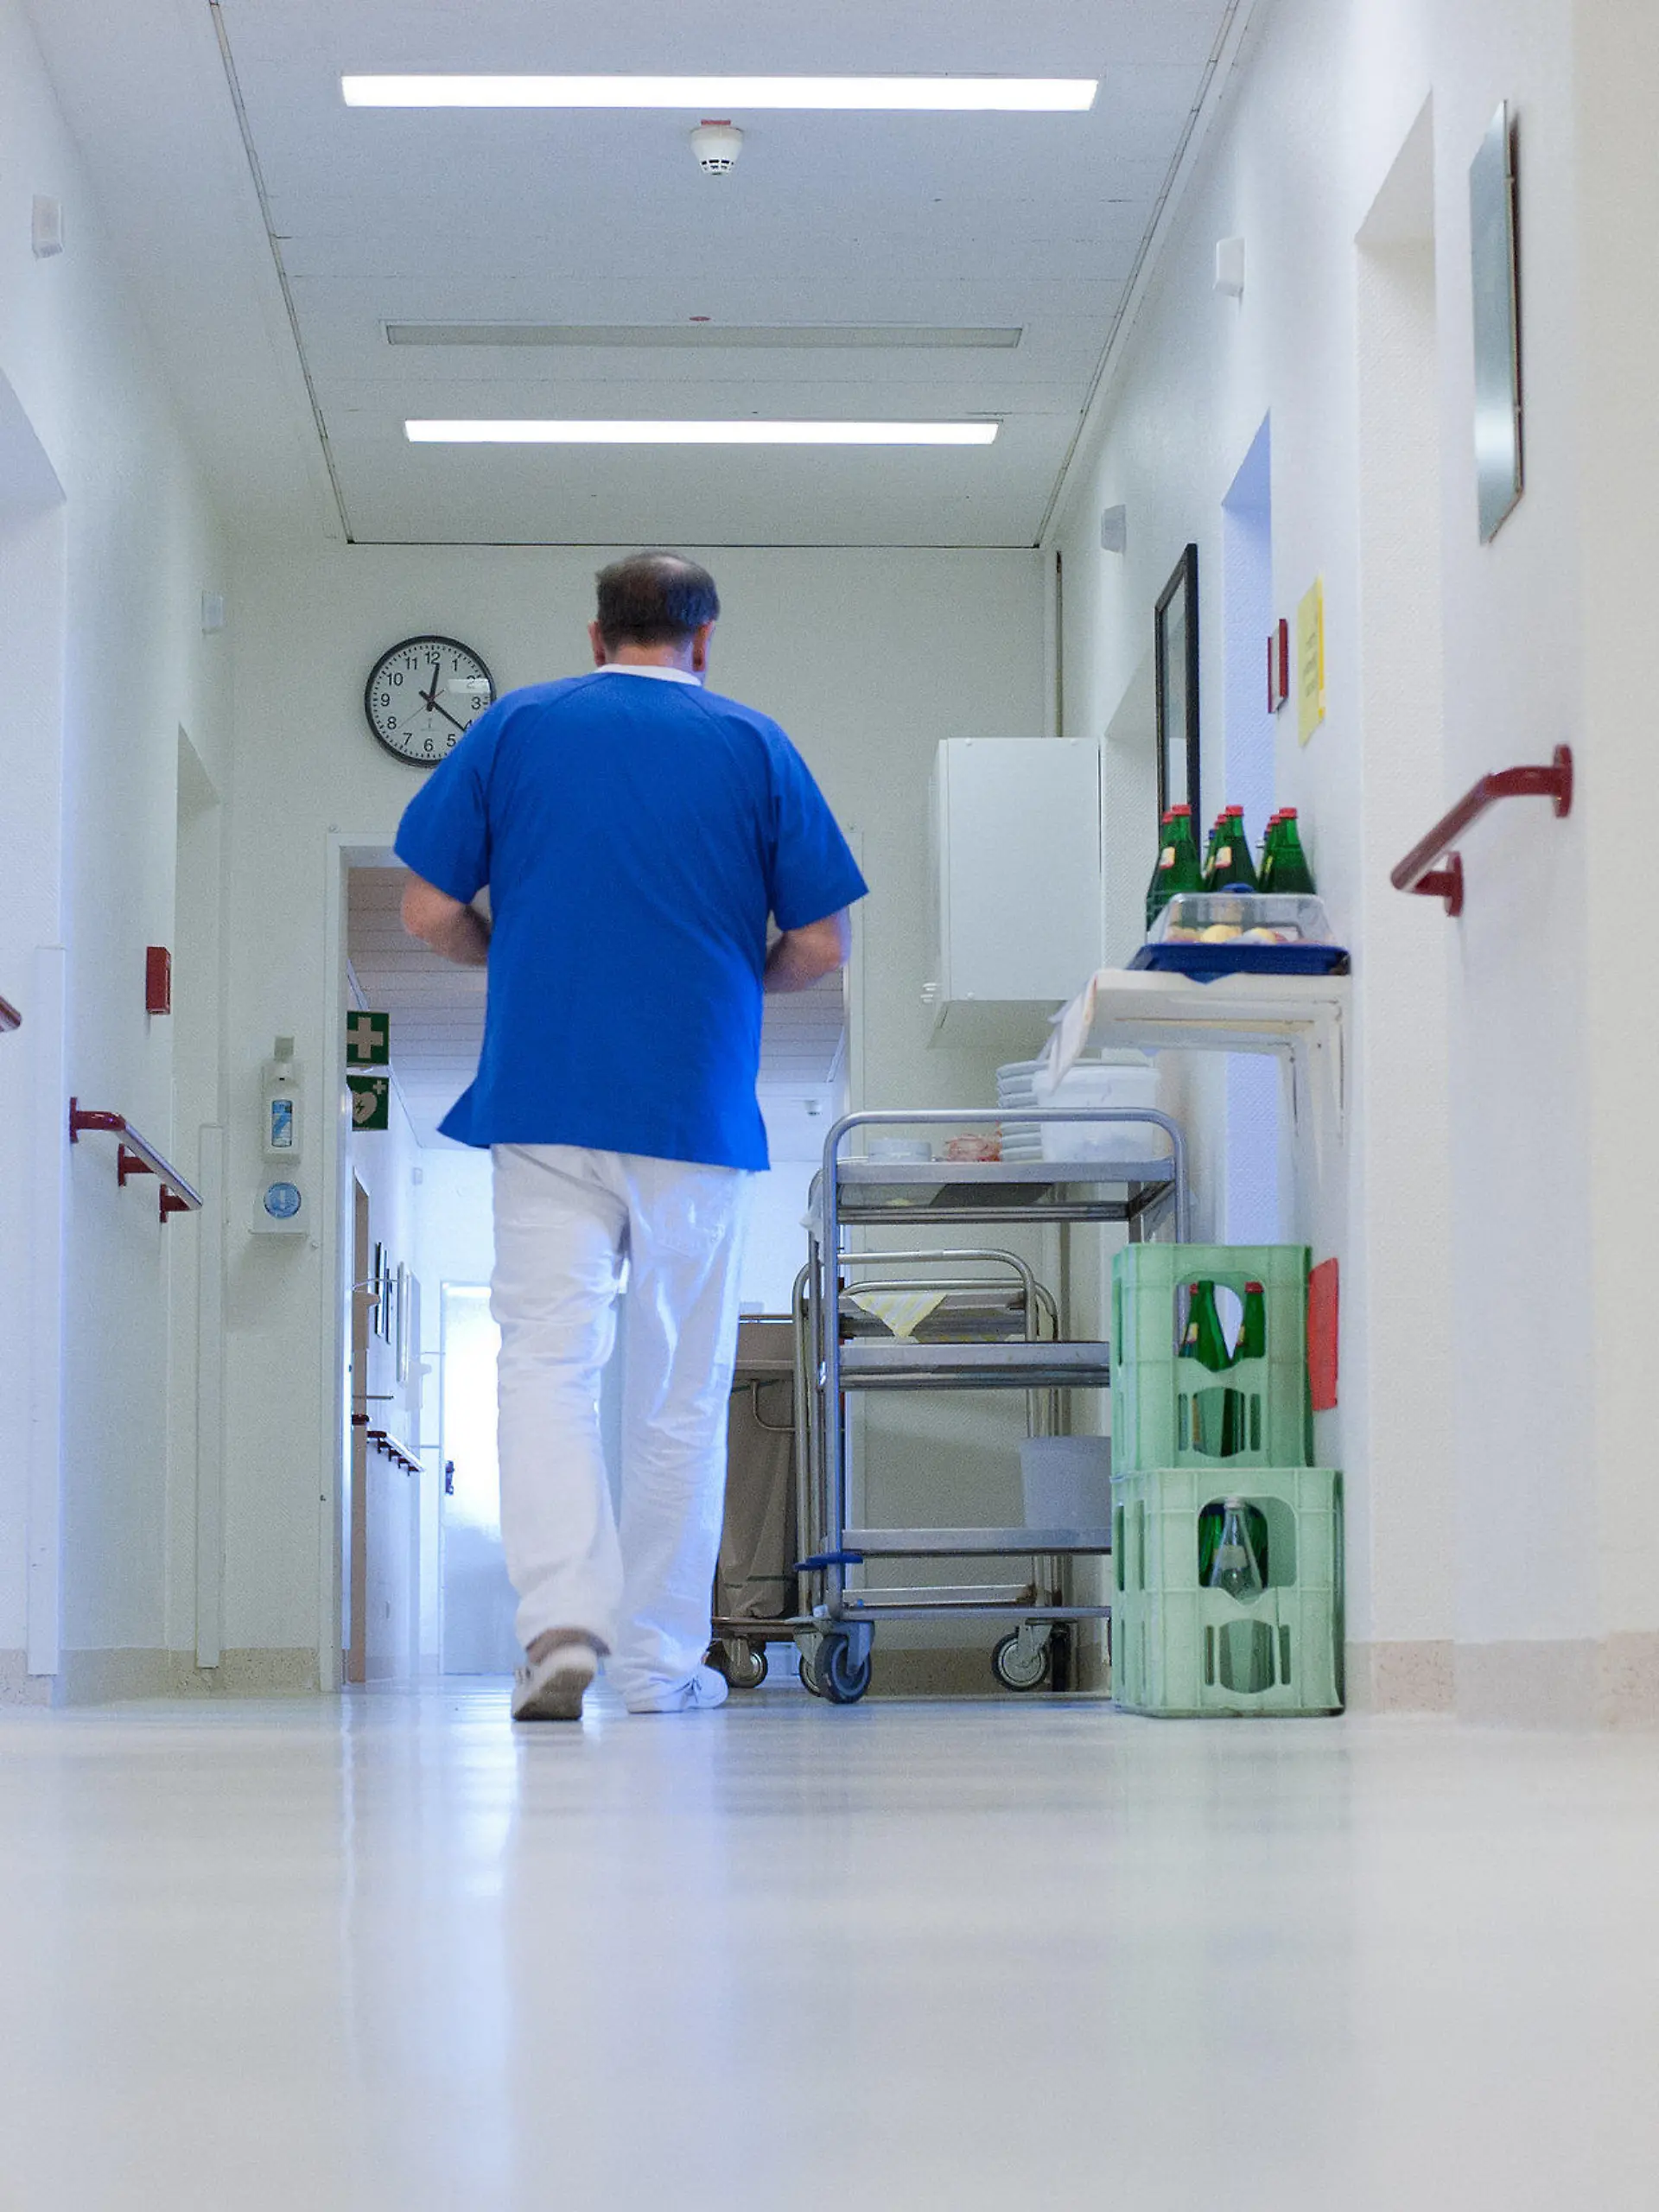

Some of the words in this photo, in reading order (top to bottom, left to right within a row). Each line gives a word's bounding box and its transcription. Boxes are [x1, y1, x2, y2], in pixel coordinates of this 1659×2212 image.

[405, 657, 418, 671] 11
[425, 652, 441, 664] 12
[452, 658, 458, 671] 1
[387, 672, 404, 686] 10
[380, 693, 391, 707] 9
[471, 696, 481, 710] 3
[387, 716, 397, 730] 8
[403, 733, 413, 746] 7
[423, 739, 434, 752] 6
[446, 734, 457, 747] 5
